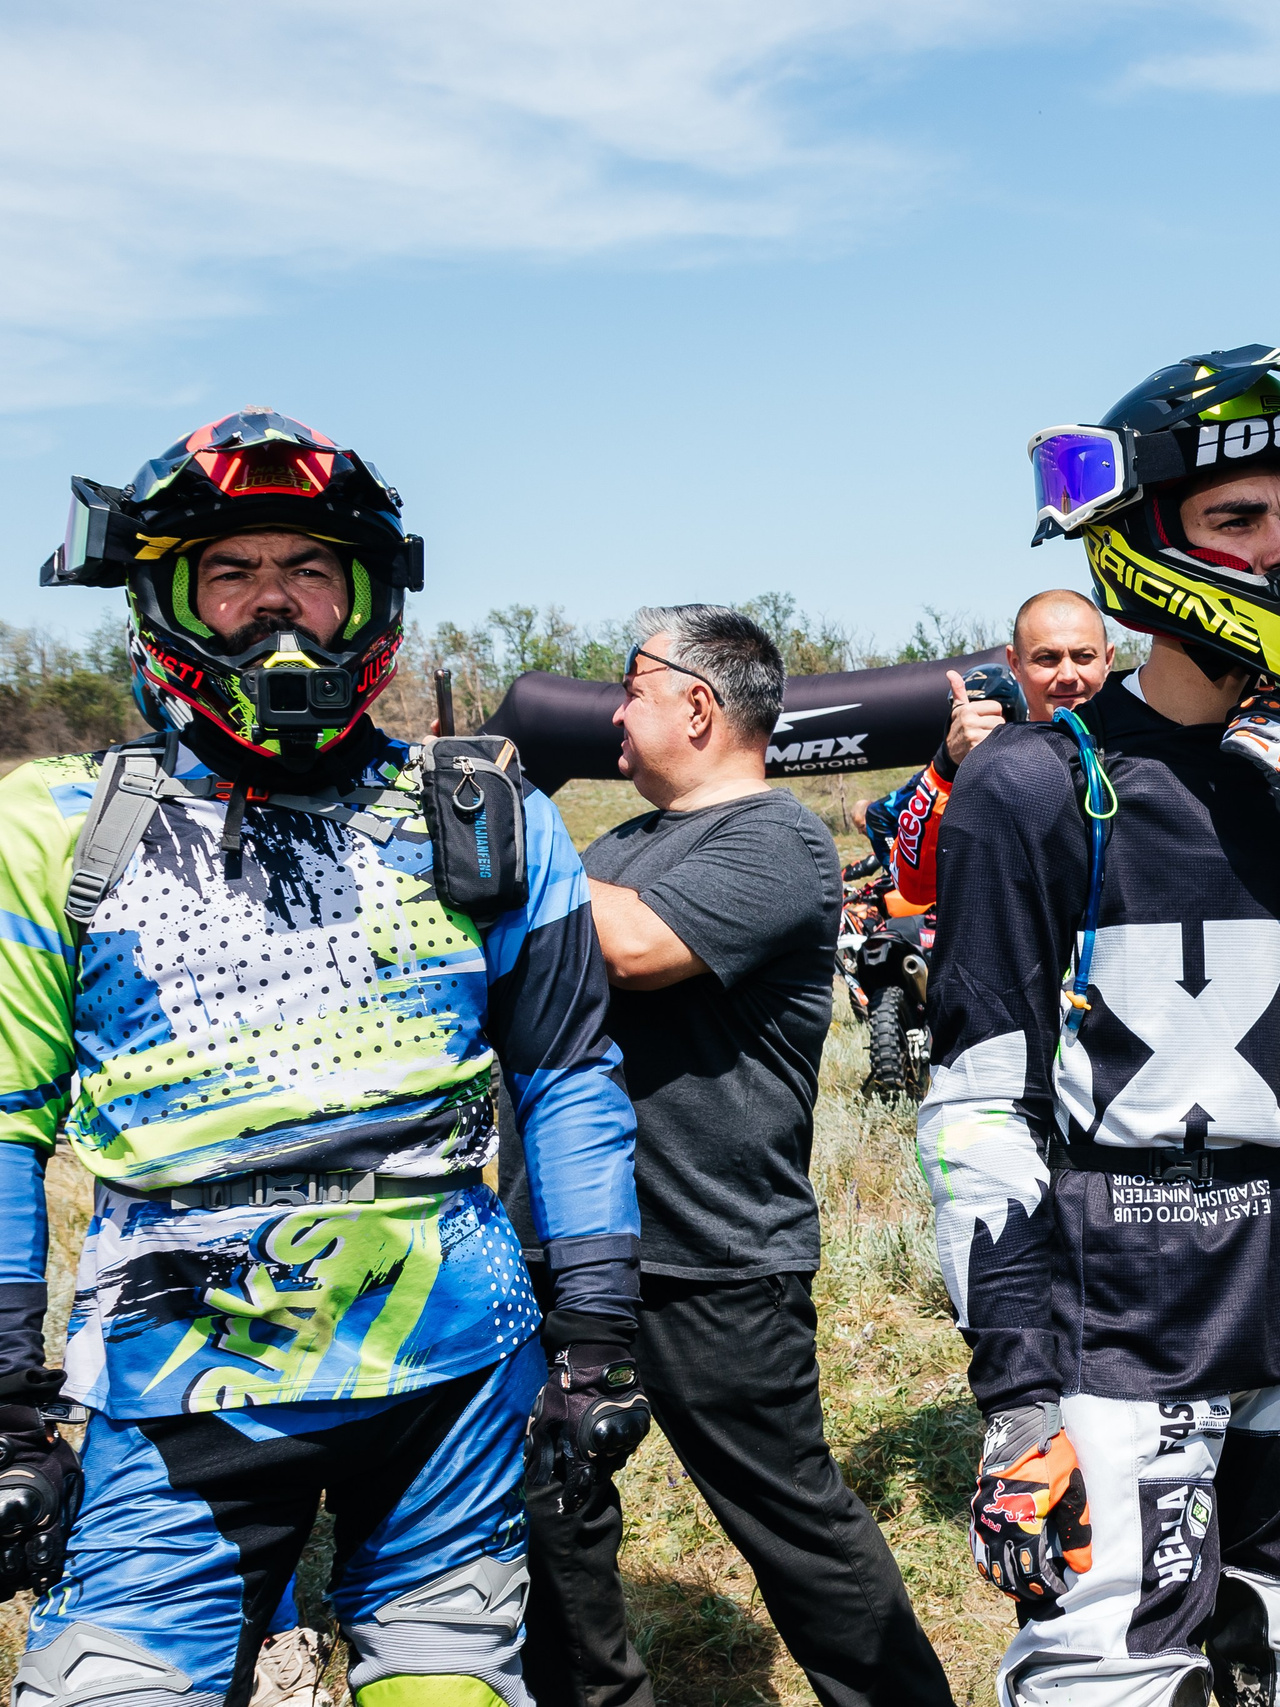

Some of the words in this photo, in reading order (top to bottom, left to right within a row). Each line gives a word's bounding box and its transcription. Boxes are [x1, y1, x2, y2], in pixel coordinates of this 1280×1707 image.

[783, 756, 869, 772] MOTORS
[472, 796, 492, 879] WAIJIANFENG
[1112, 1188, 1190, 1204] NINETEEN
[1113, 1207, 1153, 1223] CLUB
[1224, 1201, 1259, 1223] FAST
[1153, 1484, 1193, 1589] HELLA
